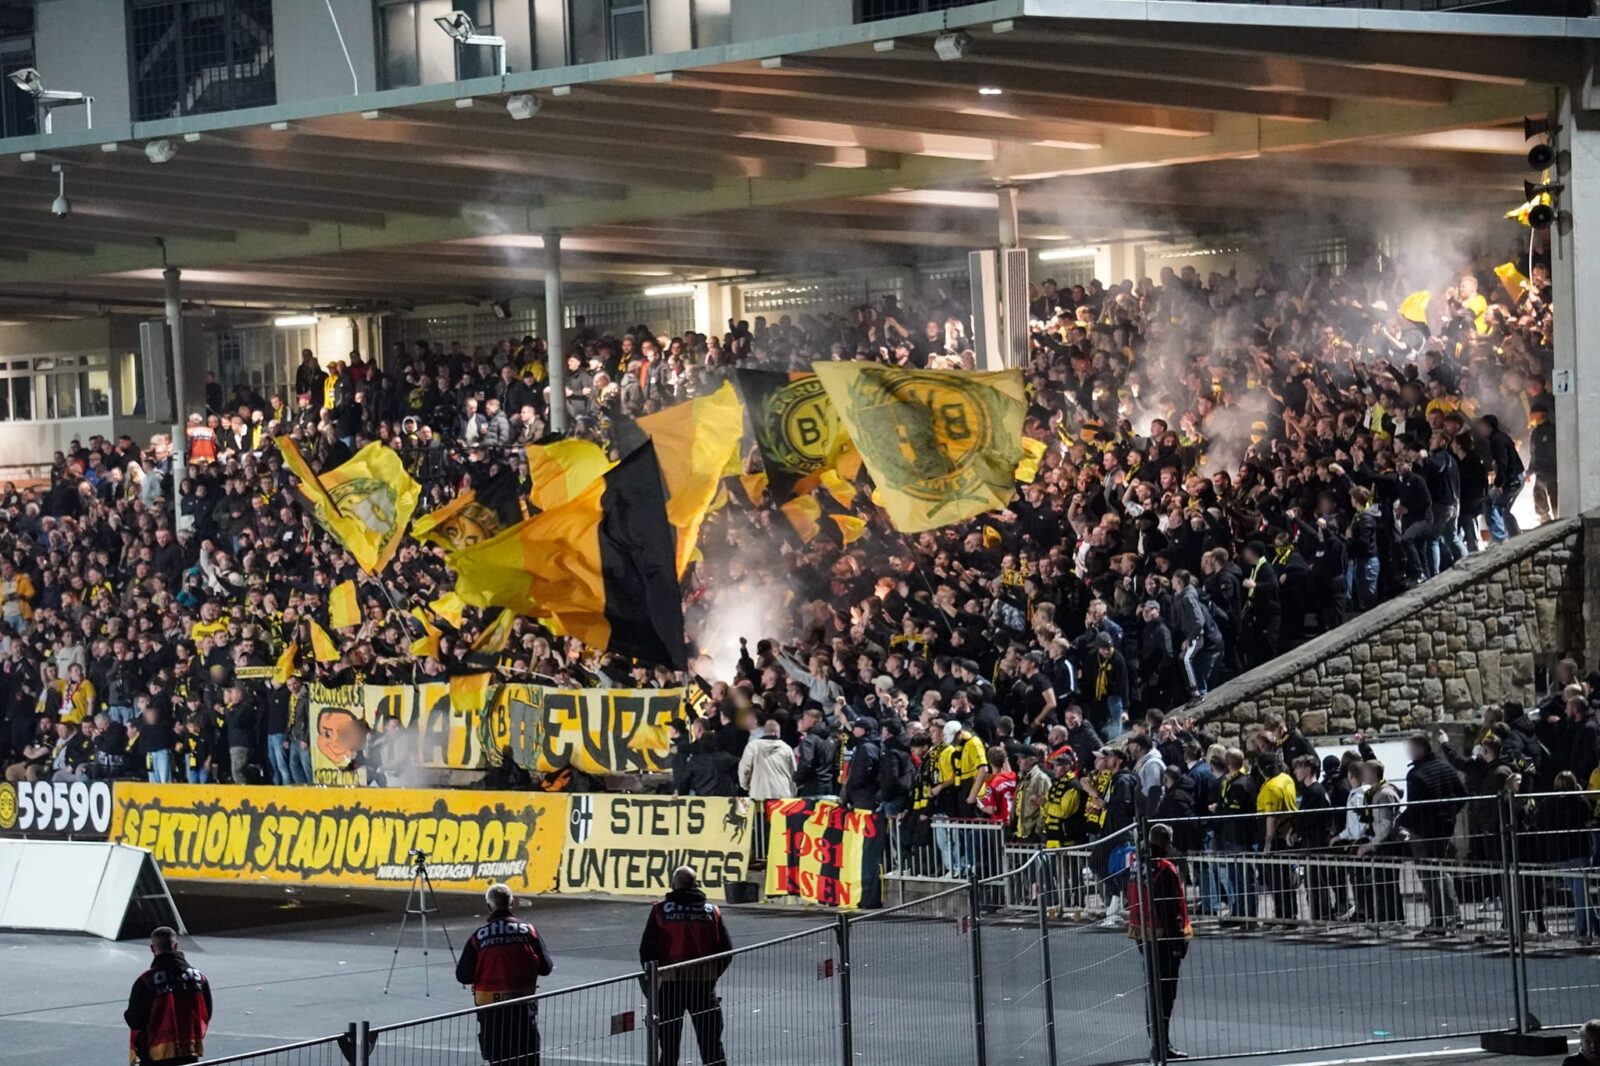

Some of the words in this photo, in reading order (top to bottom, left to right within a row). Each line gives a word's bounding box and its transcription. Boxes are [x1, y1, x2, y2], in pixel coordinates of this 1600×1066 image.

[18, 781, 111, 832] 59590
[611, 798, 706, 835] STETS
[123, 808, 251, 866] SEKTION
[782, 827, 844, 869] 1981
[567, 848, 744, 889] UNTERWEGS
[476, 920, 530, 940] atlas
